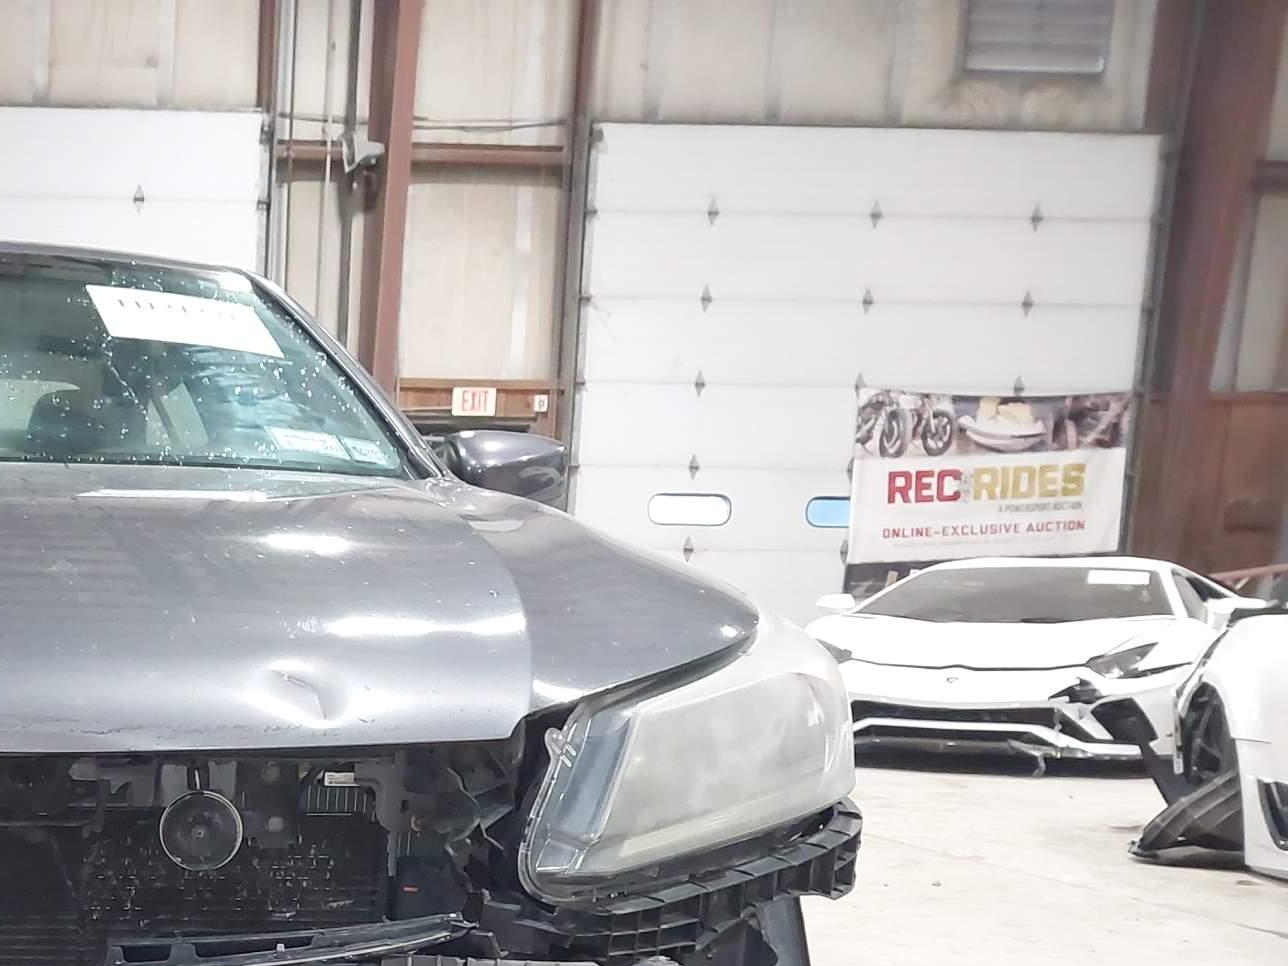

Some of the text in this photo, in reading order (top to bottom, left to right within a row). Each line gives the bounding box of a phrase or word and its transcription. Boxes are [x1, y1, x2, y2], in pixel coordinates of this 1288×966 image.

[461, 389, 489, 412] EXIT
[887, 469, 962, 504] REC
[973, 463, 1087, 501] RIDES
[882, 520, 1086, 539] ONLINE-EXCLUSIVE AUCTION
